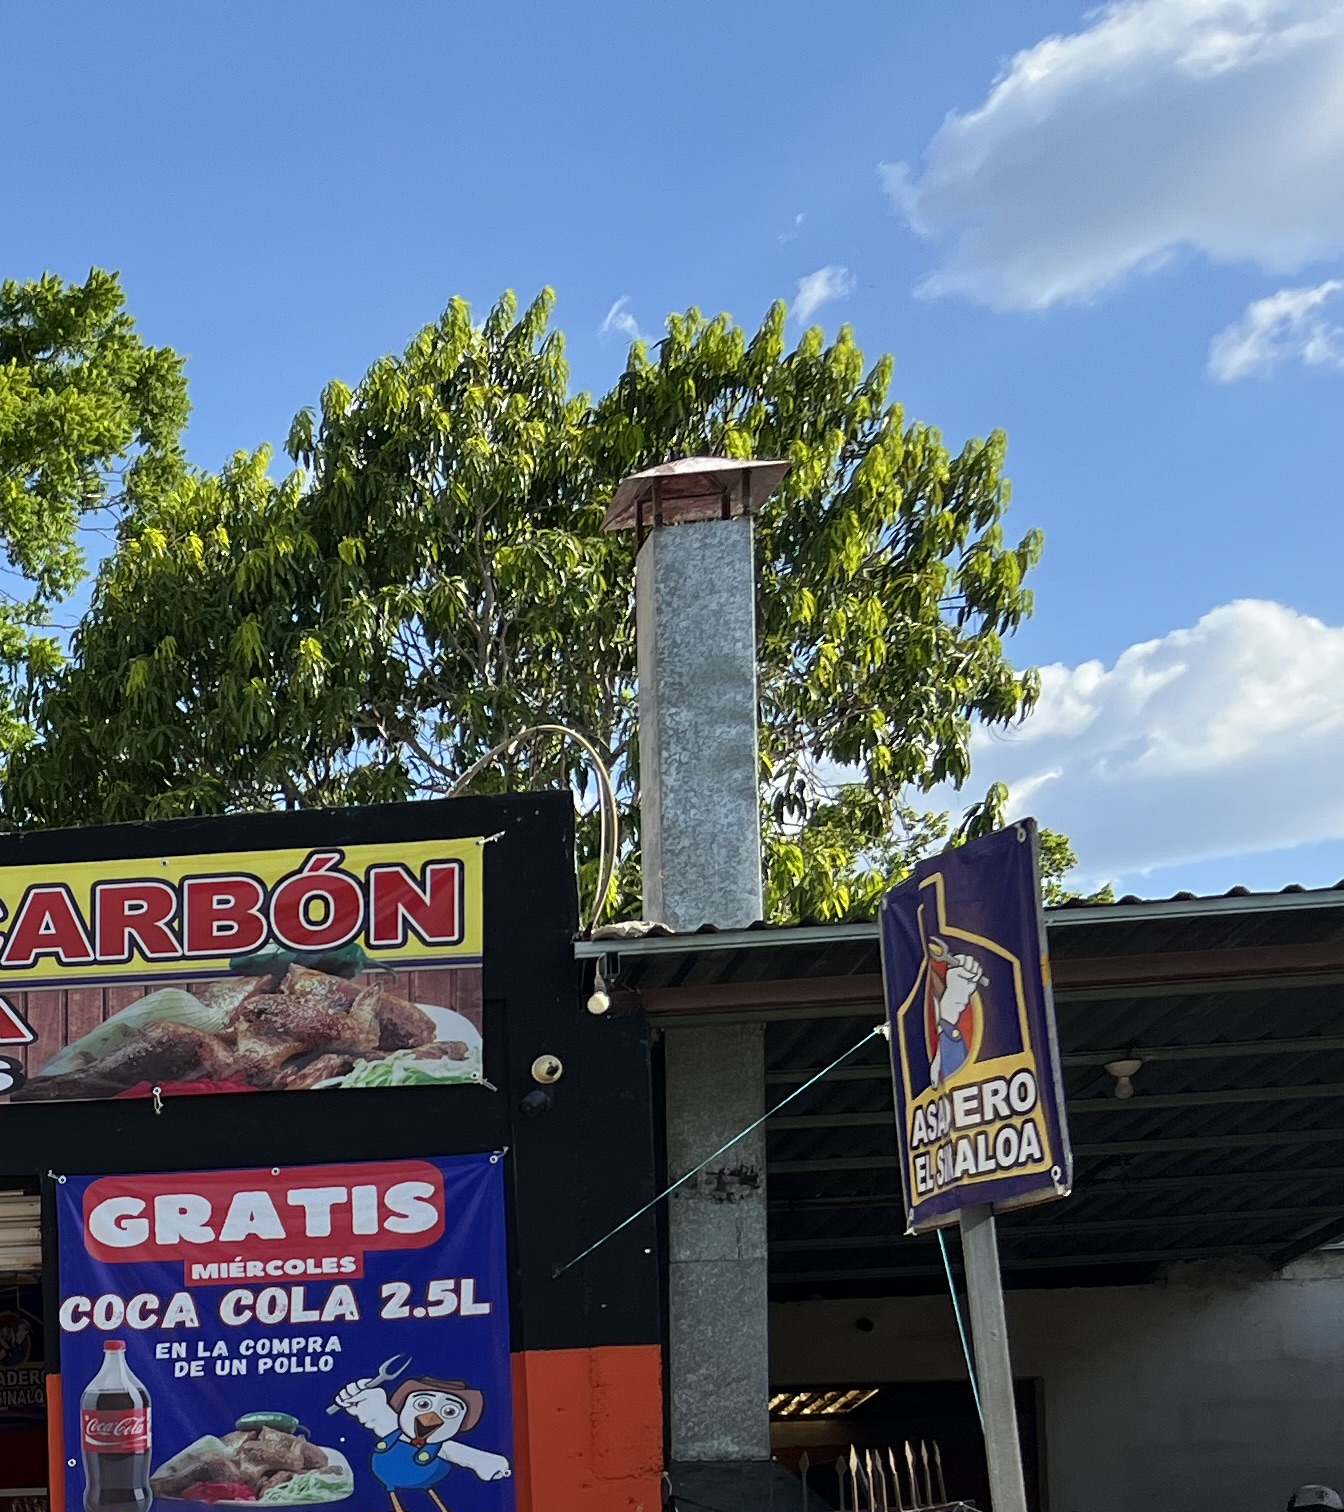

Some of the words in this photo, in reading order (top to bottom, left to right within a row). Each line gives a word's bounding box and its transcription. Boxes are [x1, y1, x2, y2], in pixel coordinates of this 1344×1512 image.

[914, 1151, 934, 1194] EL
[88, 1181, 439, 1247] GRATIS
[191, 1255, 357, 1280] MIÉRCOLES
[59, 1292, 199, 1332] COCA
[219, 1285, 359, 1326] COLA
[380, 1278, 490, 1319] 2.5L
[155, 1341, 186, 1359] EN
[197, 1339, 228, 1358] LA
[239, 1336, 342, 1356] COMPRA
[174, 1360, 204, 1378] DE
[215, 1358, 247, 1376] UN
[257, 1355, 334, 1374] POLLO
